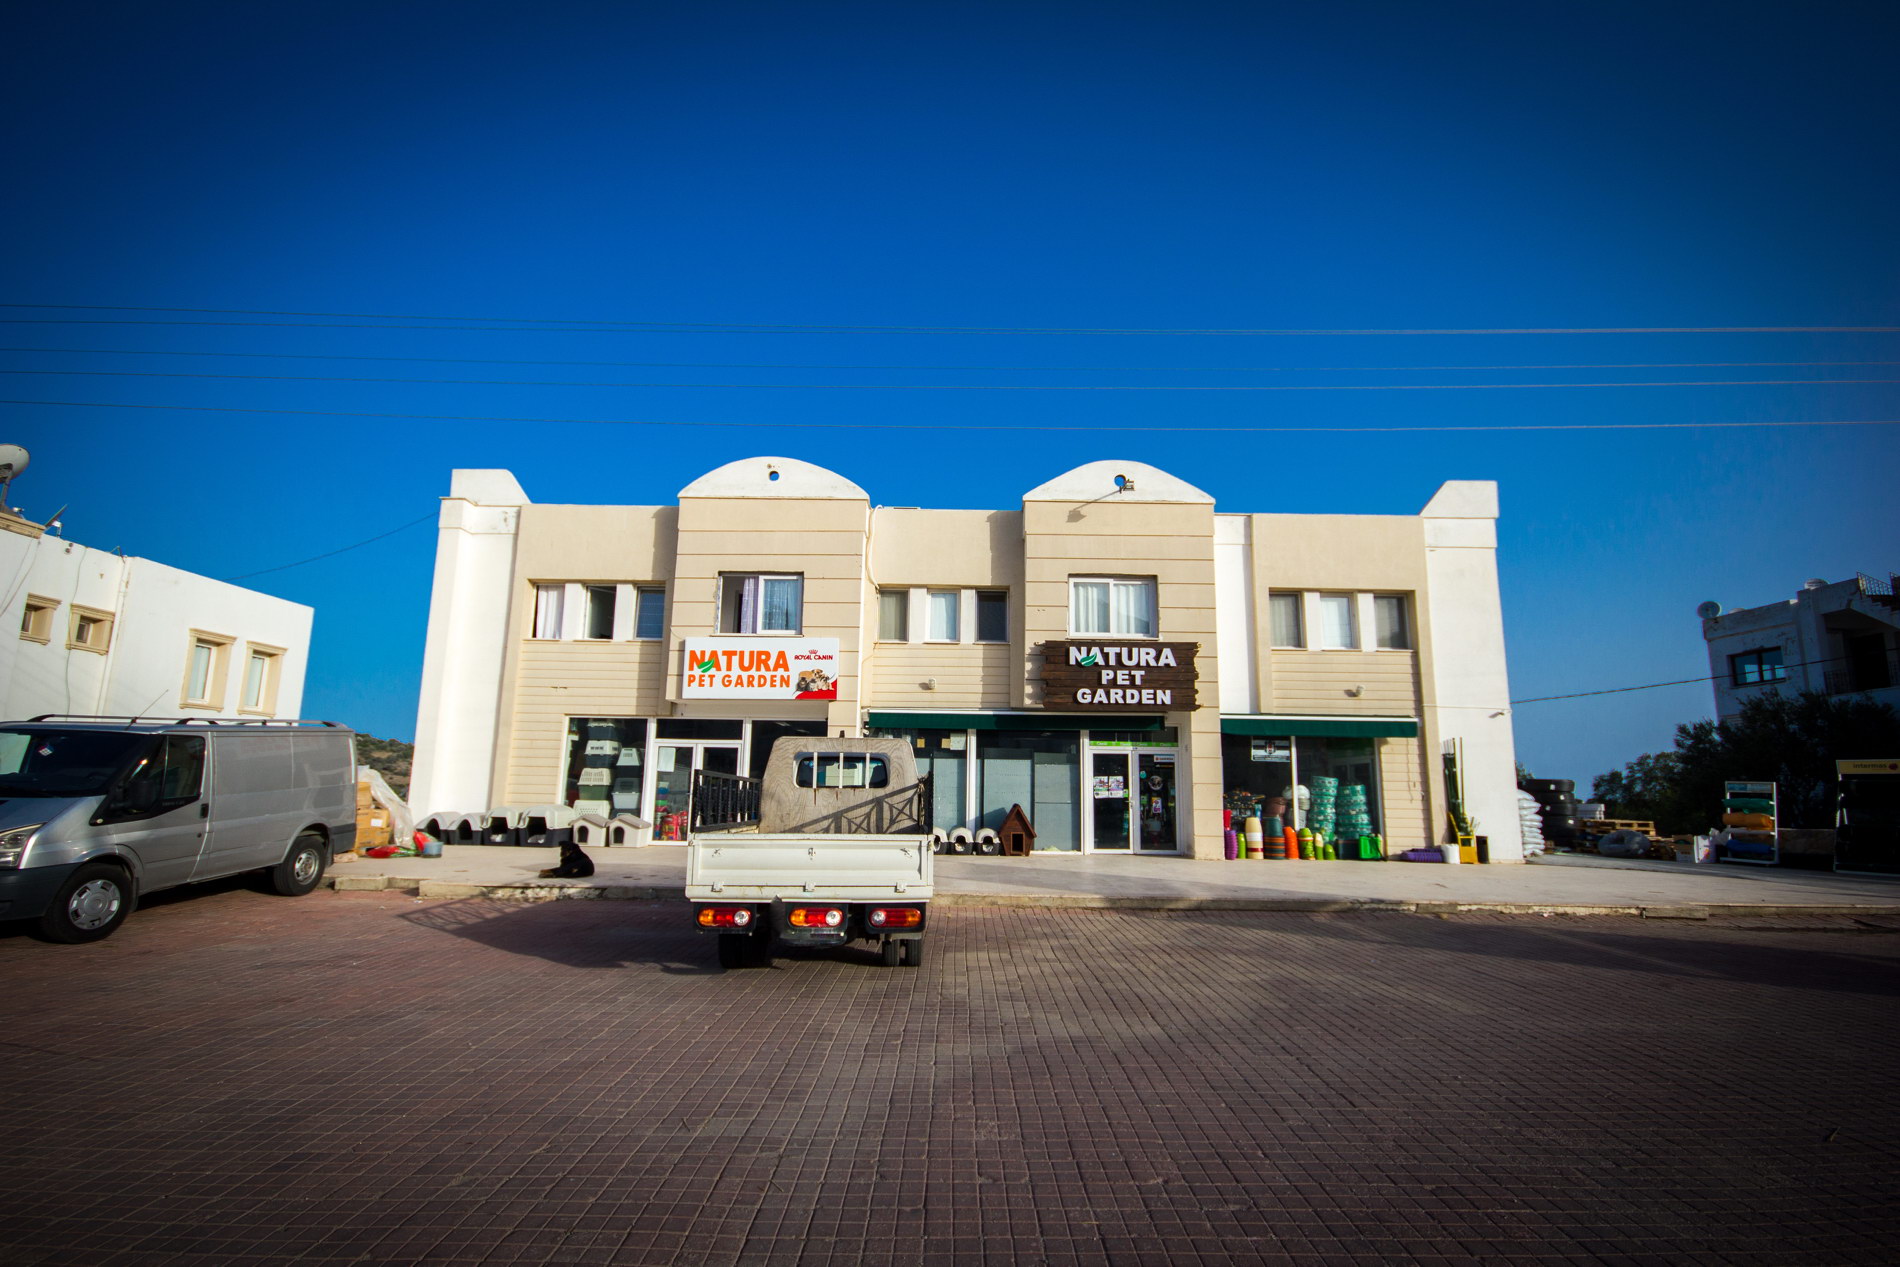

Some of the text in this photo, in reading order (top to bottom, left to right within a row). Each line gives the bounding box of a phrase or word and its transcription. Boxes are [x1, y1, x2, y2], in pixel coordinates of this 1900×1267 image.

[688, 650, 790, 672] NATURA
[1068, 646, 1177, 667] NATURA
[687, 674, 791, 688] PET GARDEN
[1101, 670, 1145, 685] PET
[1076, 688, 1171, 705] GARDEN
